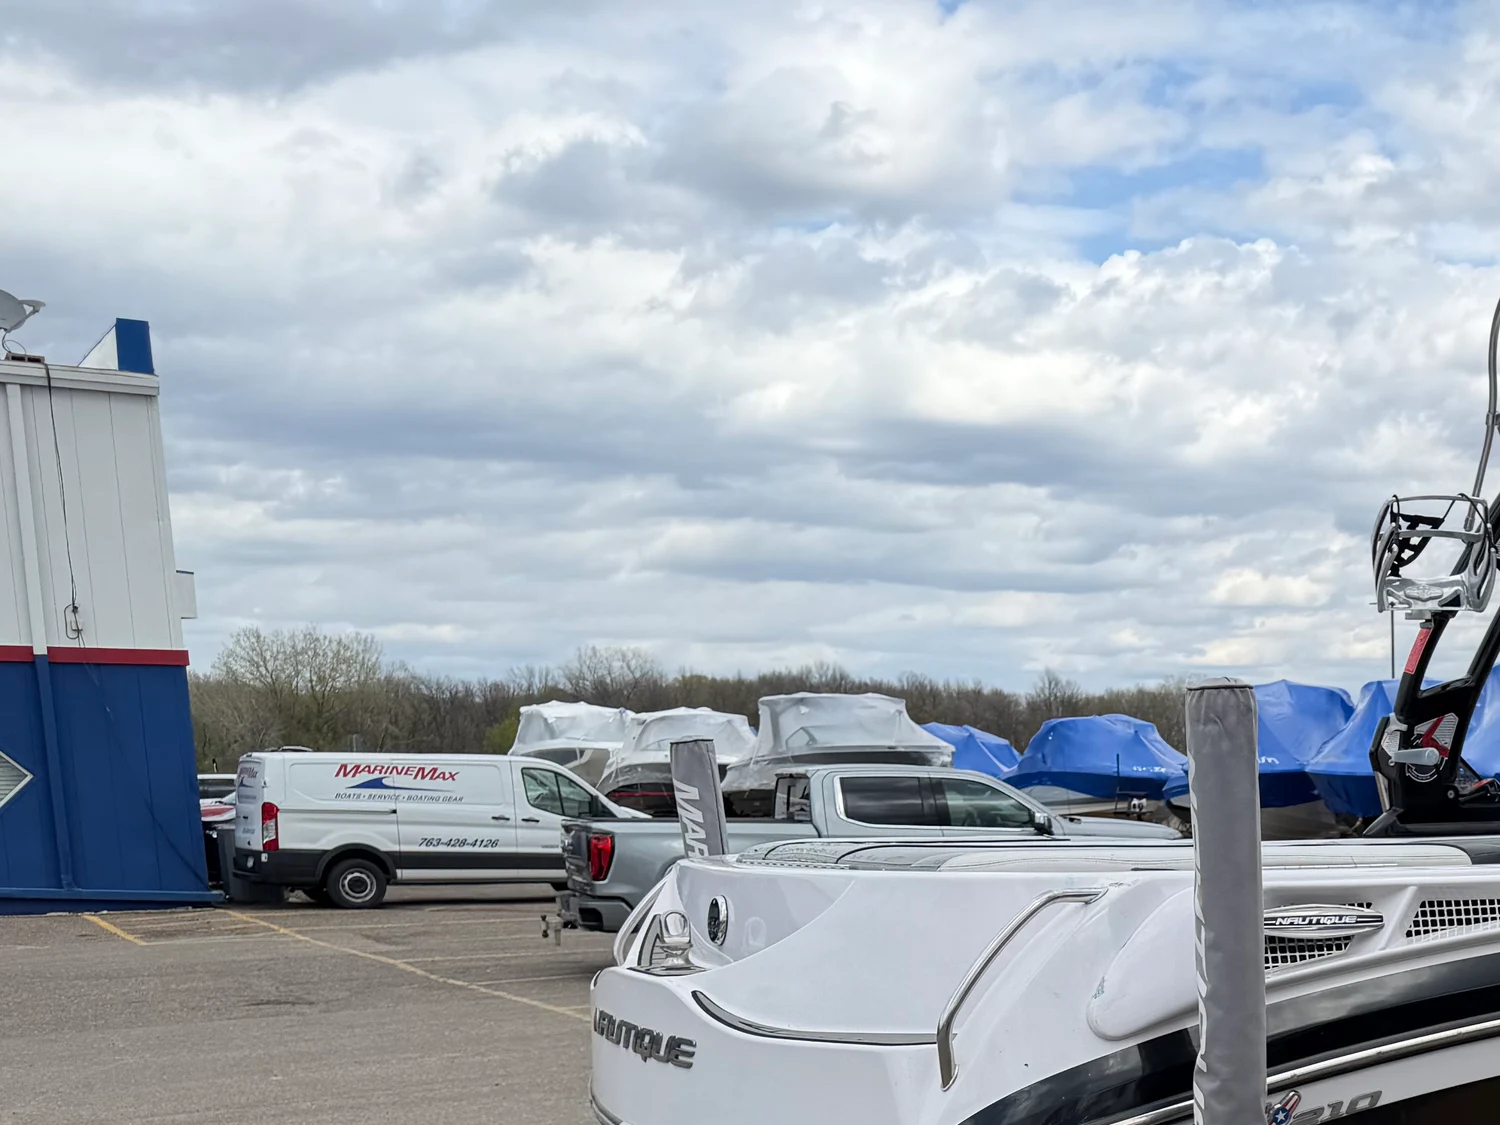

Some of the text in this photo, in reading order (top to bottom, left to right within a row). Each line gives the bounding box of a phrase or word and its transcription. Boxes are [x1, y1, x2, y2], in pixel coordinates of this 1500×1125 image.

[367, 793, 400, 801] SERVICE
[418, 837, 500, 849] 763-428-4126
[1275, 915, 1358, 926] NAUTIQUE
[593, 1007, 697, 1069] AUTIQUE
